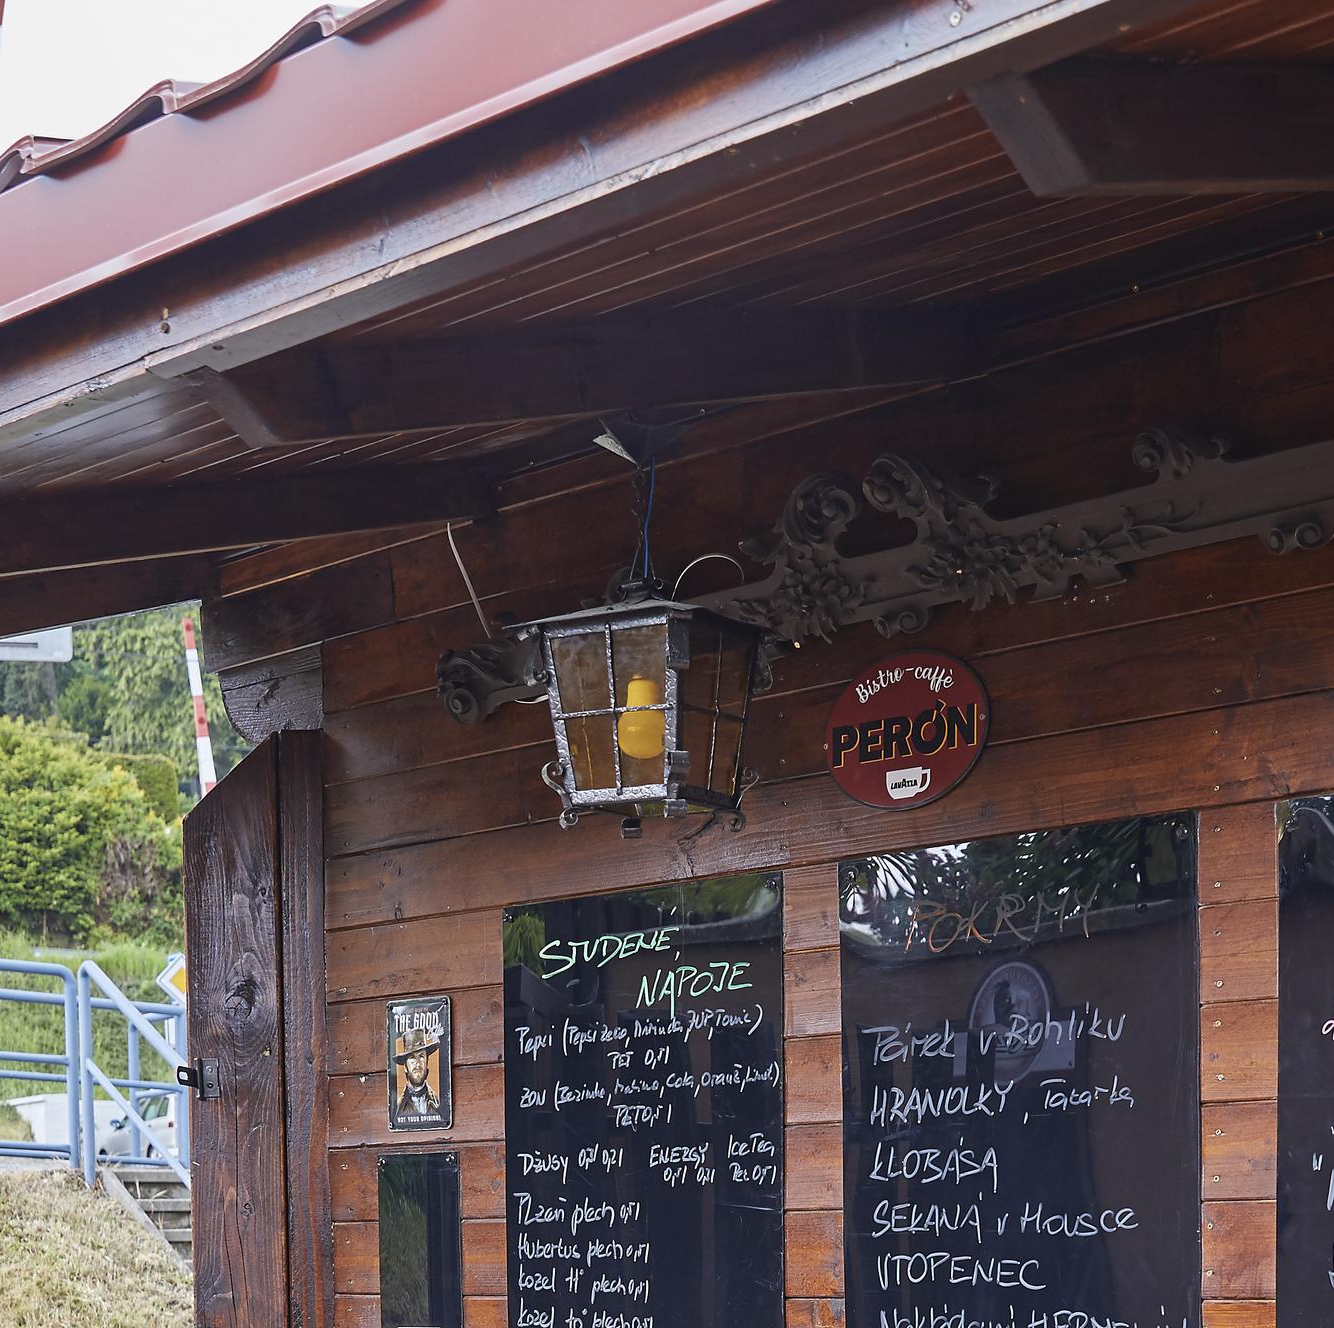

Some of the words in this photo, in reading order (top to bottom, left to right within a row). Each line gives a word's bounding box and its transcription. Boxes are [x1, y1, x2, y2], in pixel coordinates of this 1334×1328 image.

[855, 665, 955, 704] Bistro-caffè
[832, 699, 978, 769] PERÓN
[890, 778, 918, 790] LAVAZZA
[904, 882, 1101, 955] POKRMY
[538, 906, 680, 980] STUDENÉ
[635, 951, 754, 1021] NÁPOJE
[394, 1014, 411, 1032] THE
[861, 1018, 956, 1066] Párek
[979, 1028, 997, 1056] v
[520, 1087, 546, 1108] ZON
[650, 1141, 709, 1170] ENERGY
[871, 1192, 983, 1244] SEKANÁ
[997, 1213, 1009, 1236] v
